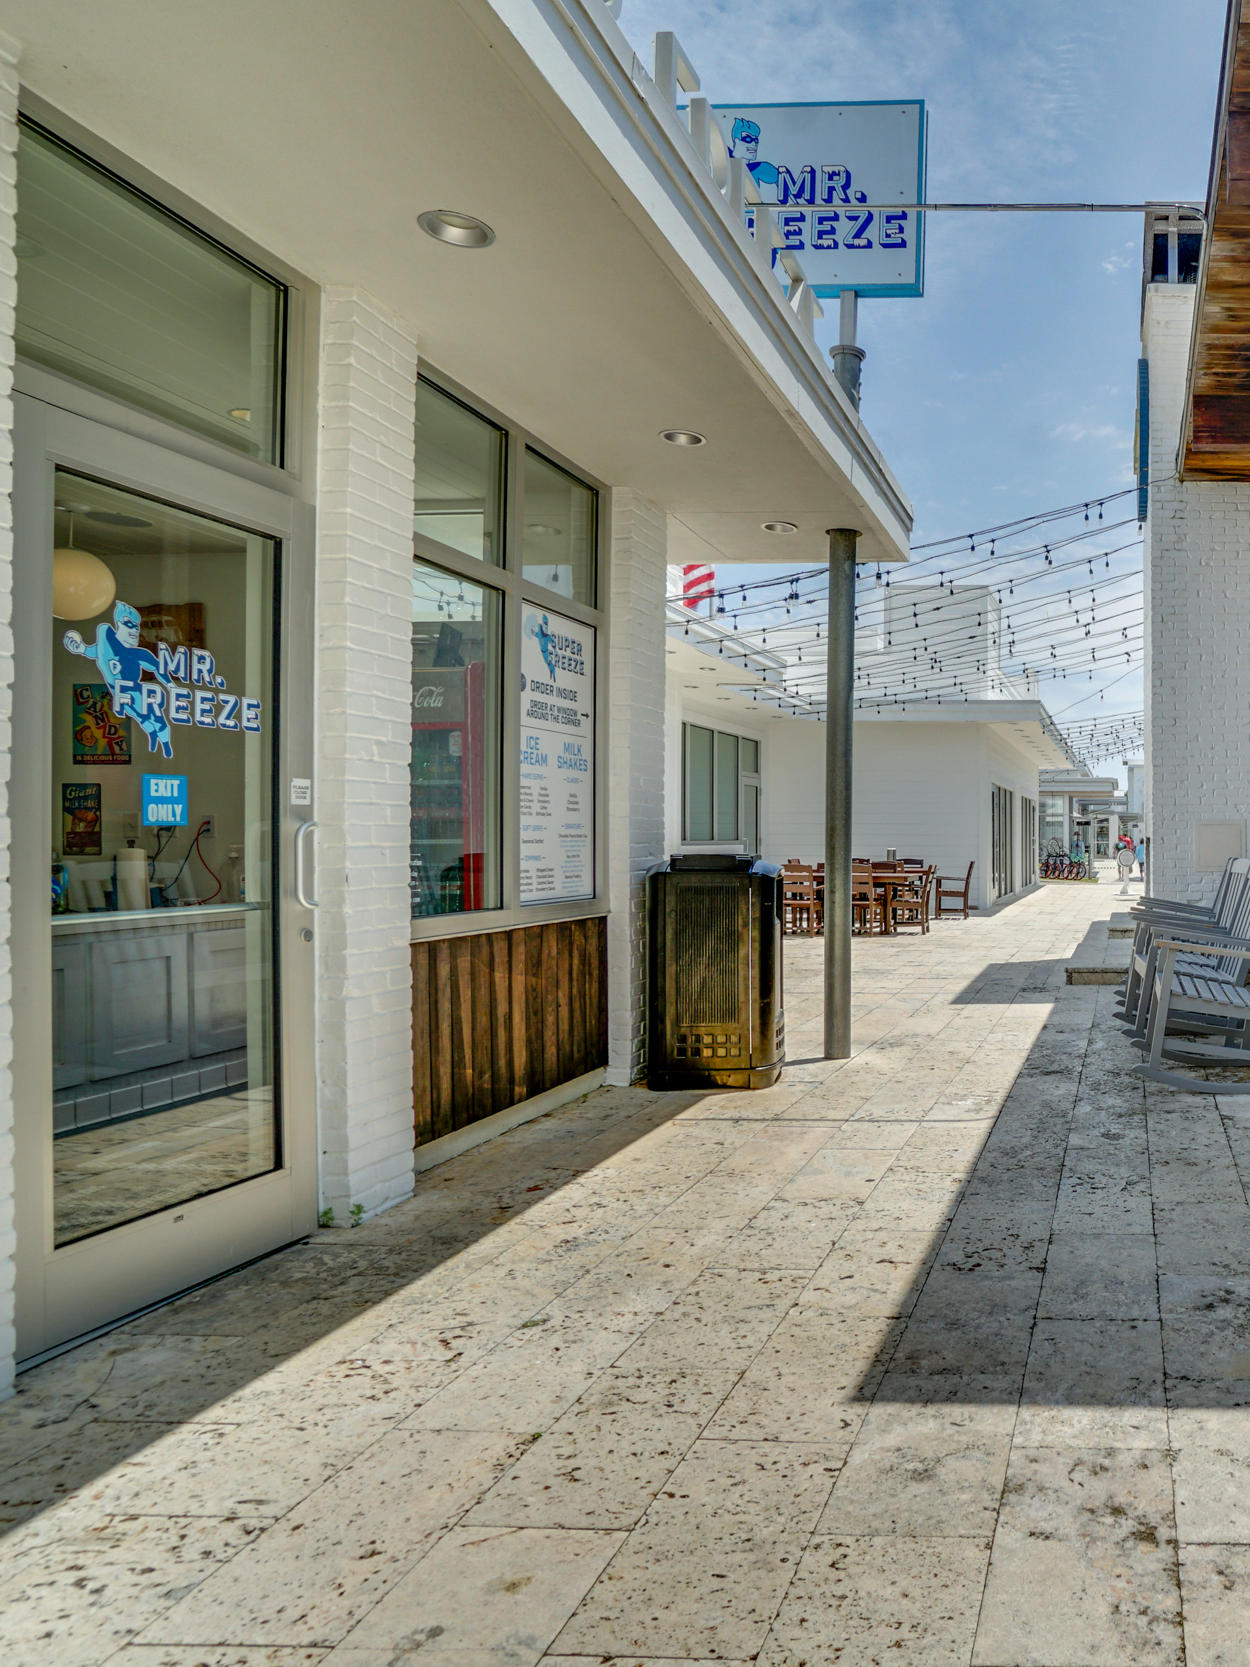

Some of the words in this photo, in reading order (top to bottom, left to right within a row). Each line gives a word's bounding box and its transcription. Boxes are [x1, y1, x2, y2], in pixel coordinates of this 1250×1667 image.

[777, 165, 867, 205] MR.
[745, 210, 908, 250] EEZE
[550, 632, 583, 657] SUPER
[158, 641, 226, 689] MR.
[548, 649, 585, 676] FREEZE
[414, 686, 445, 708] Cola
[530, 680, 554, 697] ORDER
[556, 686, 578, 702] INSIDE
[112, 679, 262, 733] FREEZE
[530, 699, 549, 711] ORDER
[549, 704, 555, 713] AT
[557, 706, 578, 718] WINDOW
[78, 687, 128, 752] CANDY
[527, 708, 549, 721] AROUND
[550, 713, 560, 724] THE
[561, 715, 581, 727] CORNER
[526, 736, 540, 751] ICE
[563, 741, 582, 757] MILK
[557, 755, 588, 772] SHAKES
[66, 785, 97, 799] Giant
[150, 779, 181, 797] EXIT
[147, 804, 183, 822] ONLY
